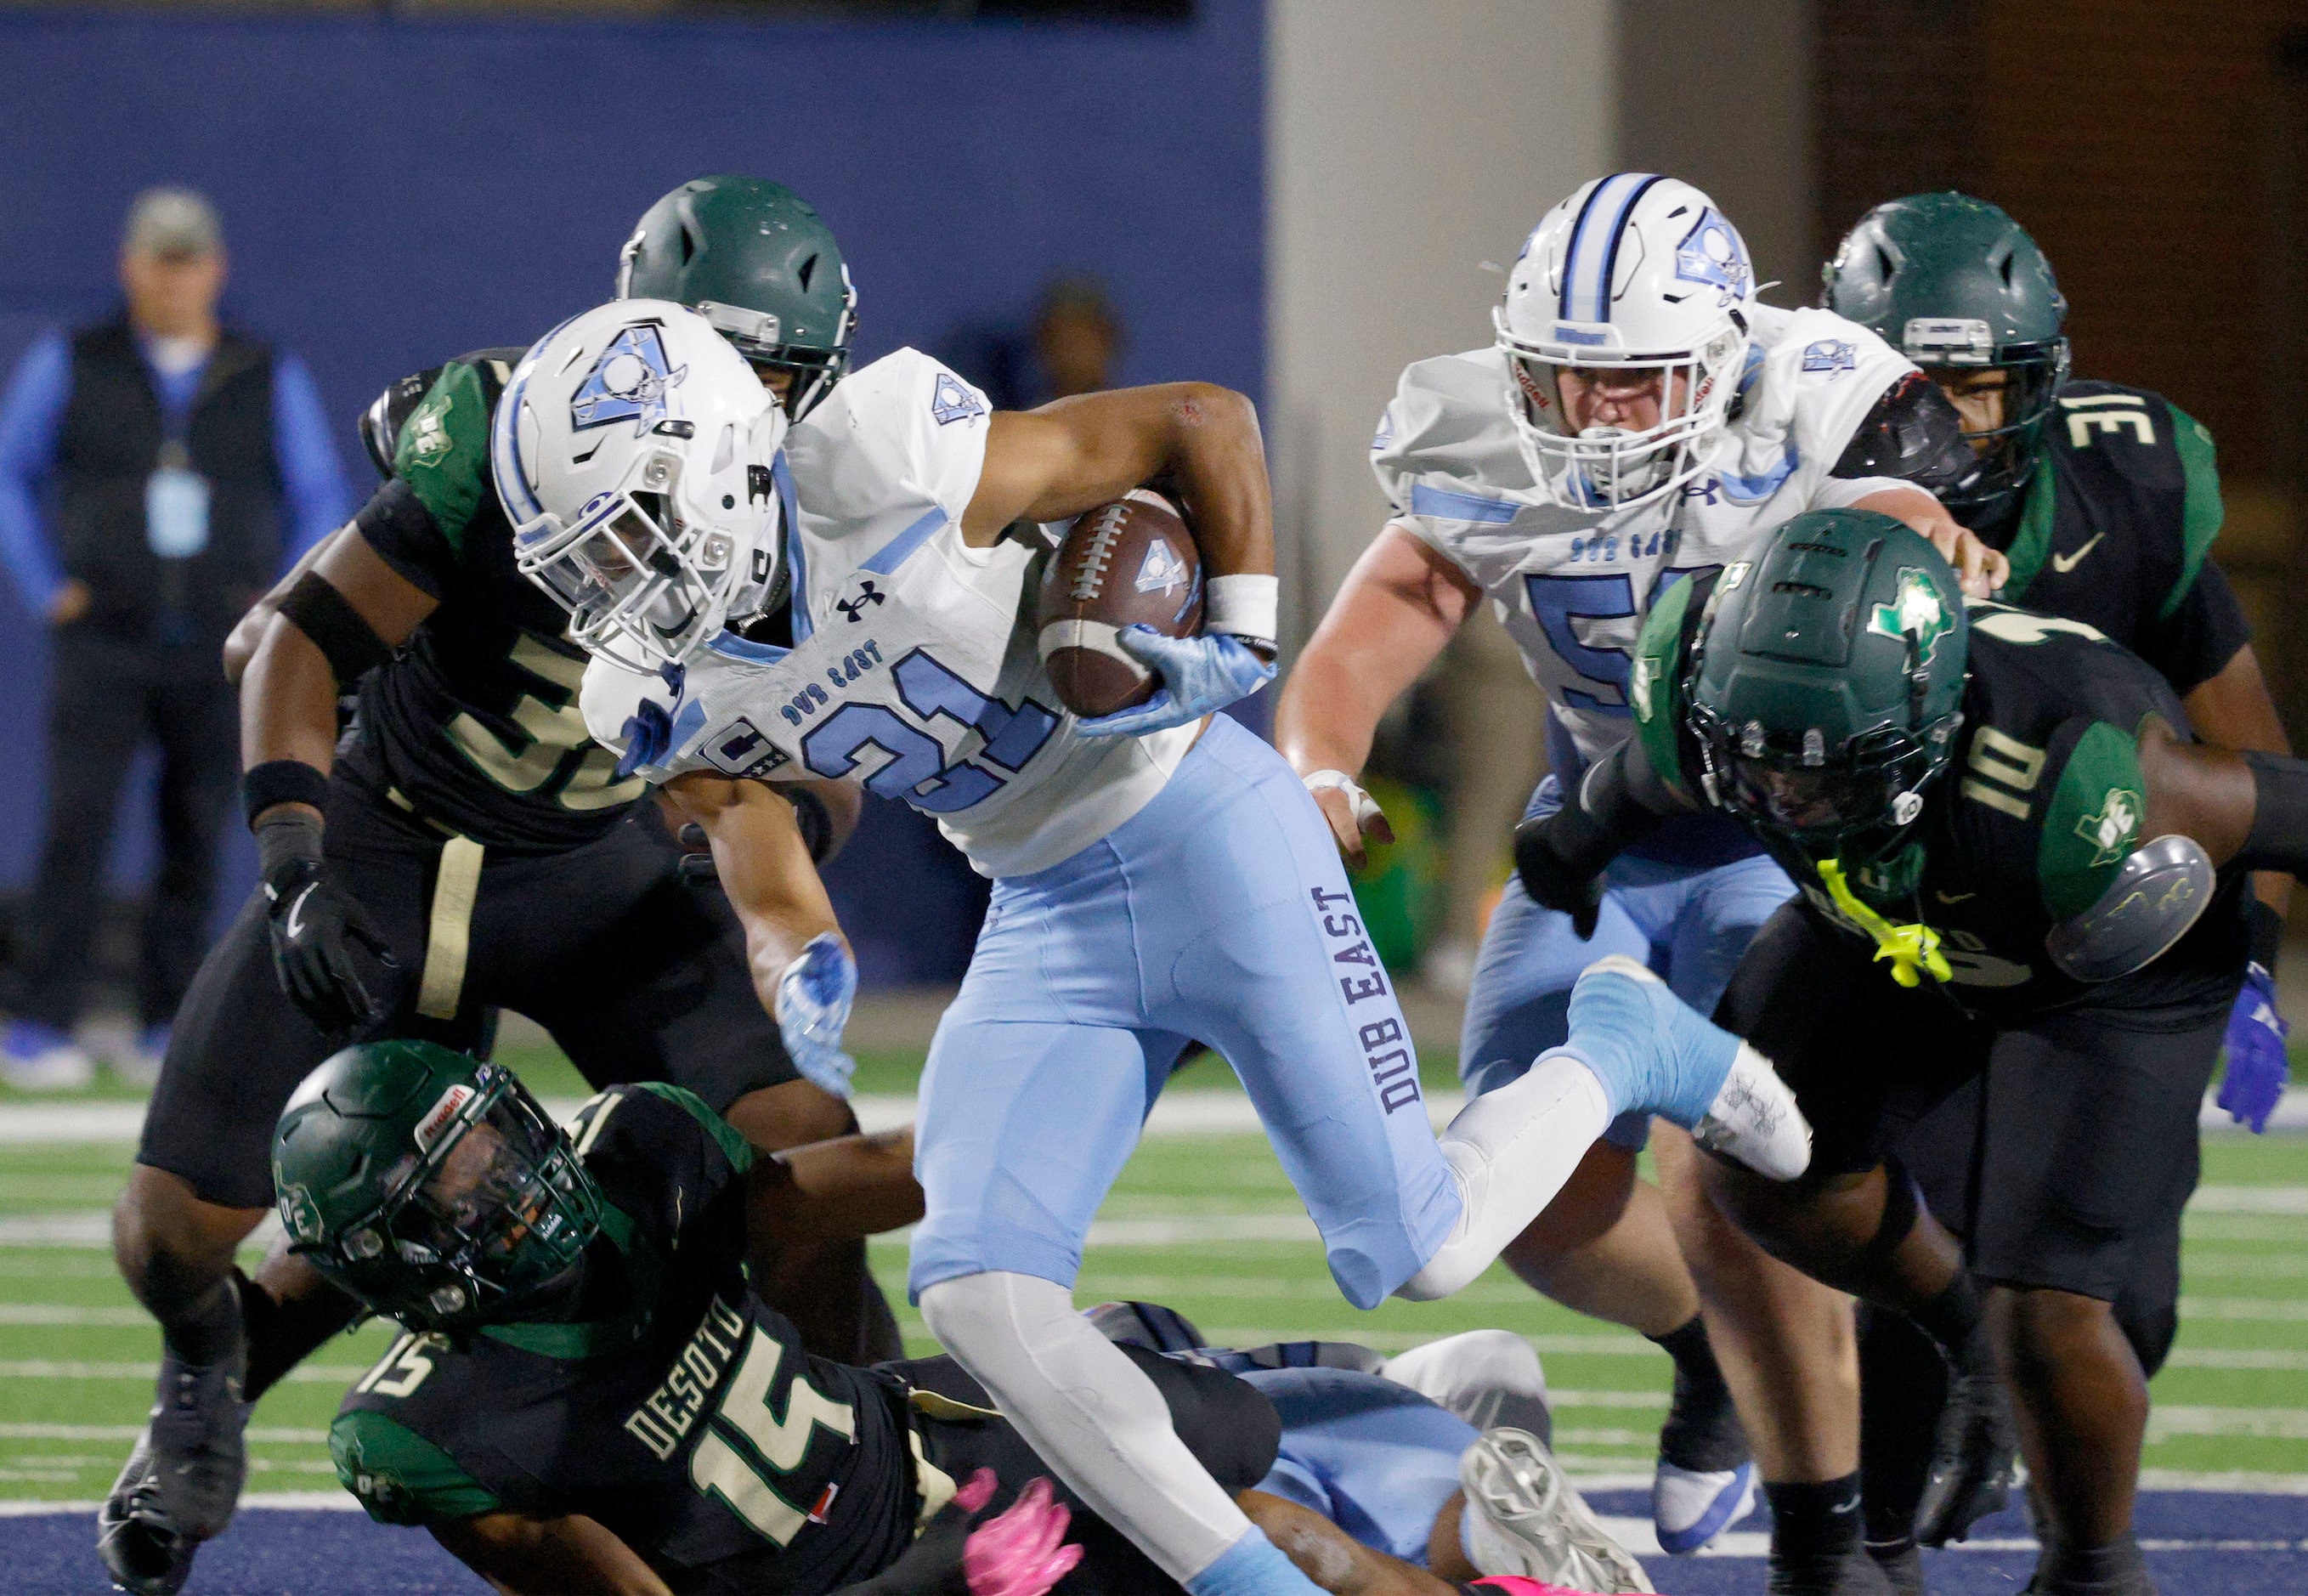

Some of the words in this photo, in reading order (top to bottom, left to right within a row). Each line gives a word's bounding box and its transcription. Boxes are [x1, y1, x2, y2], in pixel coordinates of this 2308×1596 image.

[2057, 393, 2157, 449] 31
[780, 682, 829, 727] DUB
[827, 638, 882, 689] EAST
[1523, 563, 1725, 719] 5
[703, 721, 774, 776] C
[800, 646, 1062, 814] 21
[1959, 725, 2047, 822] 10
[1310, 886, 1388, 1006] EAST
[1359, 1016, 1421, 1115] DUB
[356, 1331, 450, 1399] 15
[624, 1292, 744, 1462] DESOTO
[687, 1323, 855, 1550] 15
